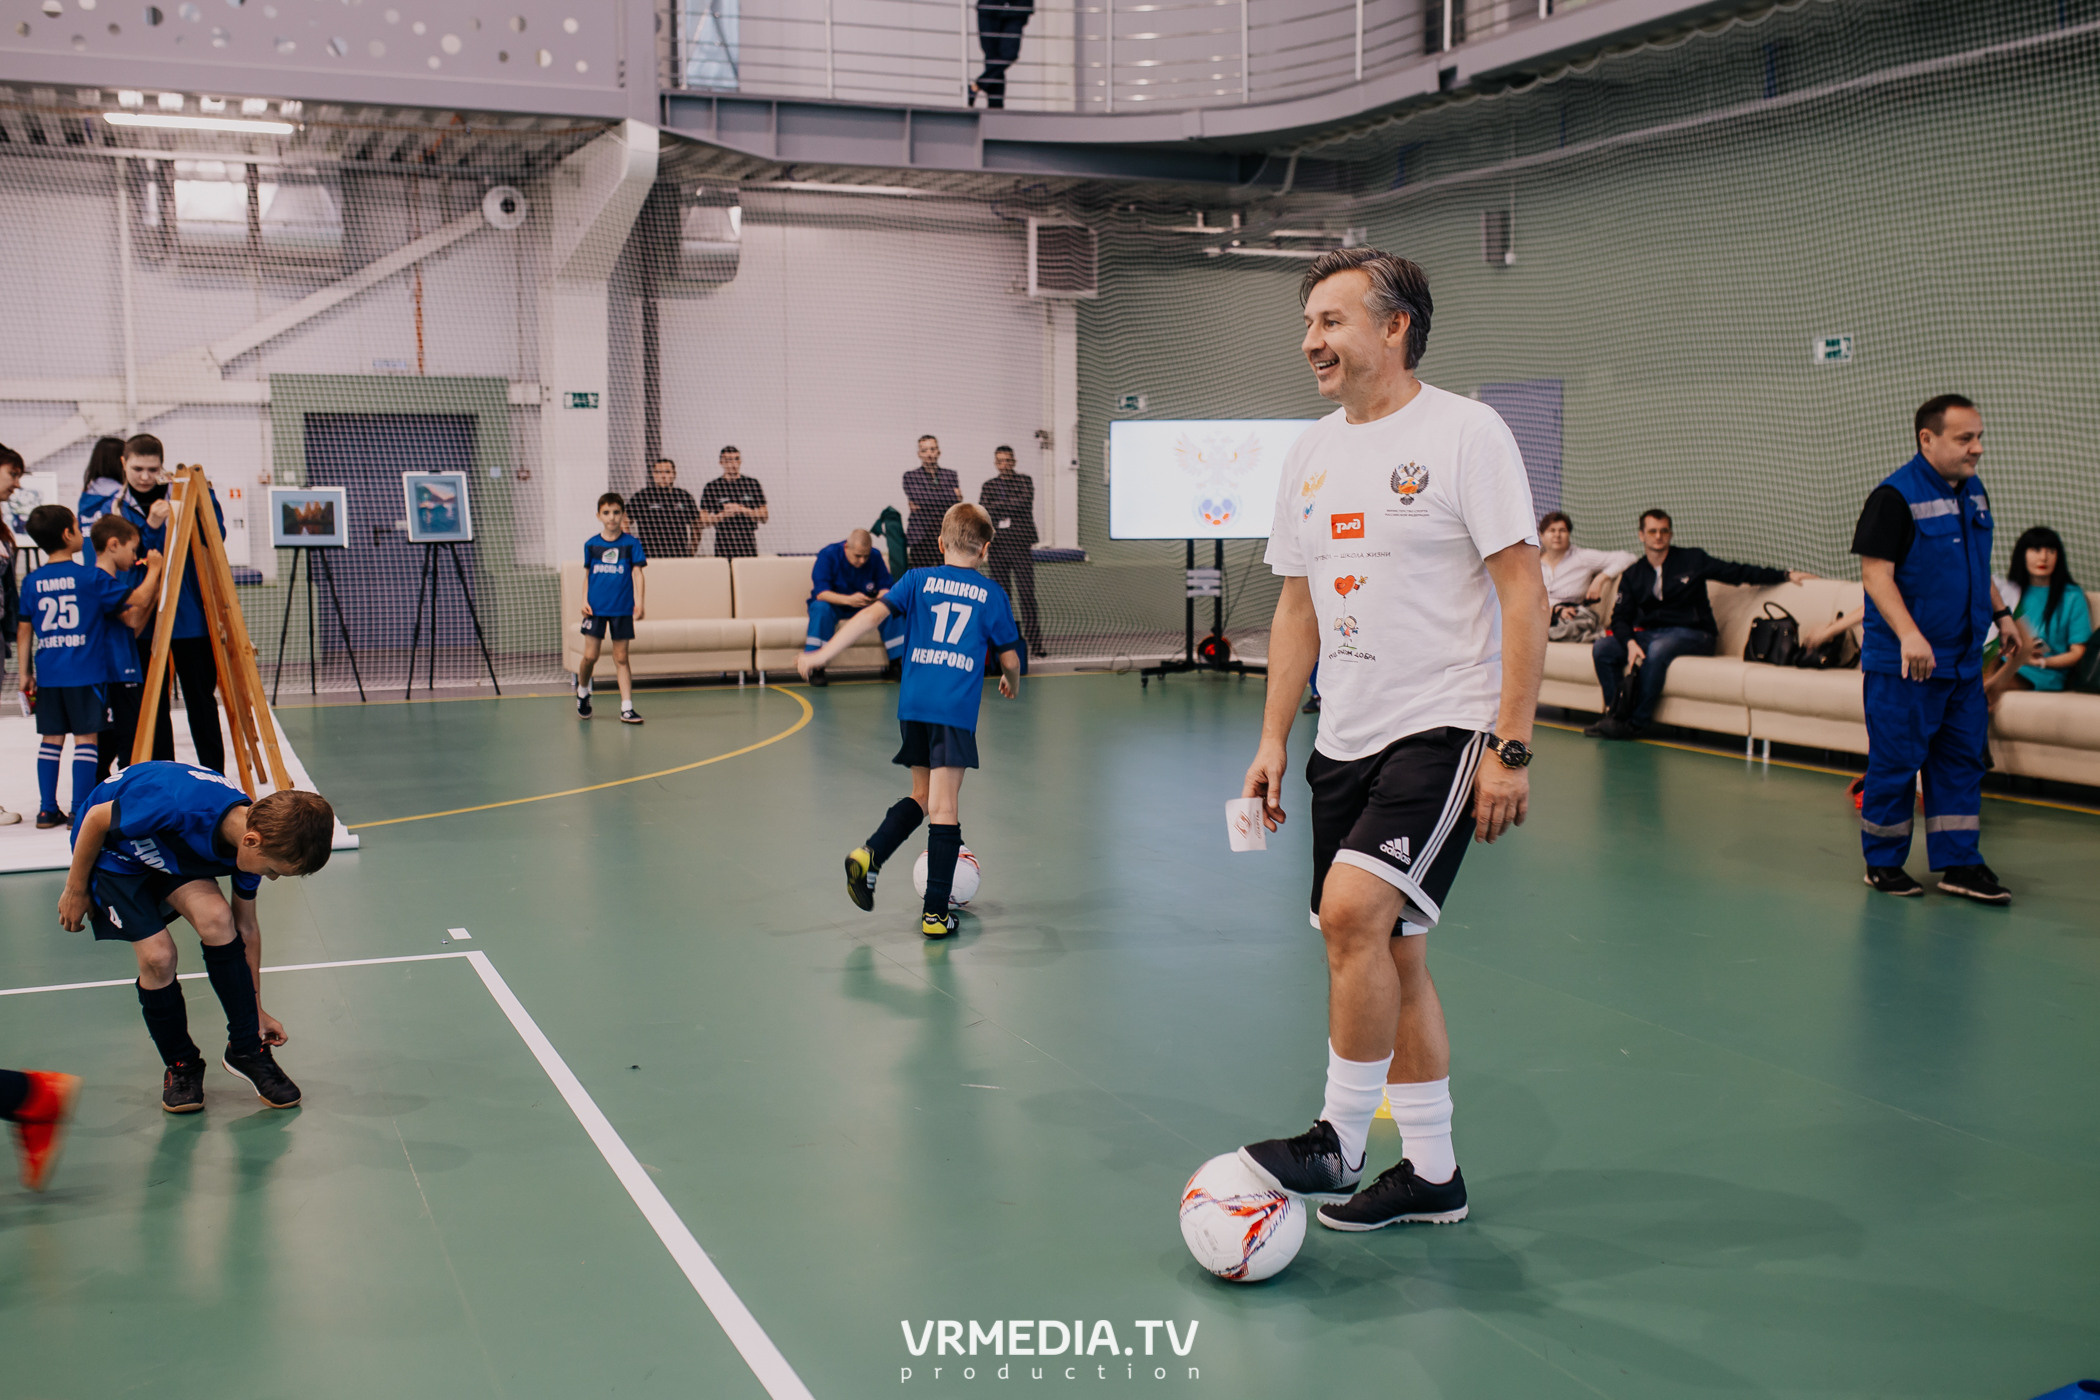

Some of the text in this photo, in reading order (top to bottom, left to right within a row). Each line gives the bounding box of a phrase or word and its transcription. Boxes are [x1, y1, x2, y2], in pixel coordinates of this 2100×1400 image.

[36, 576, 76, 593] ГАМОВ
[923, 577, 988, 604] ДАШКОВ
[38, 594, 80, 632] 25
[931, 601, 973, 645] 17
[1379, 843, 1412, 866] adidas
